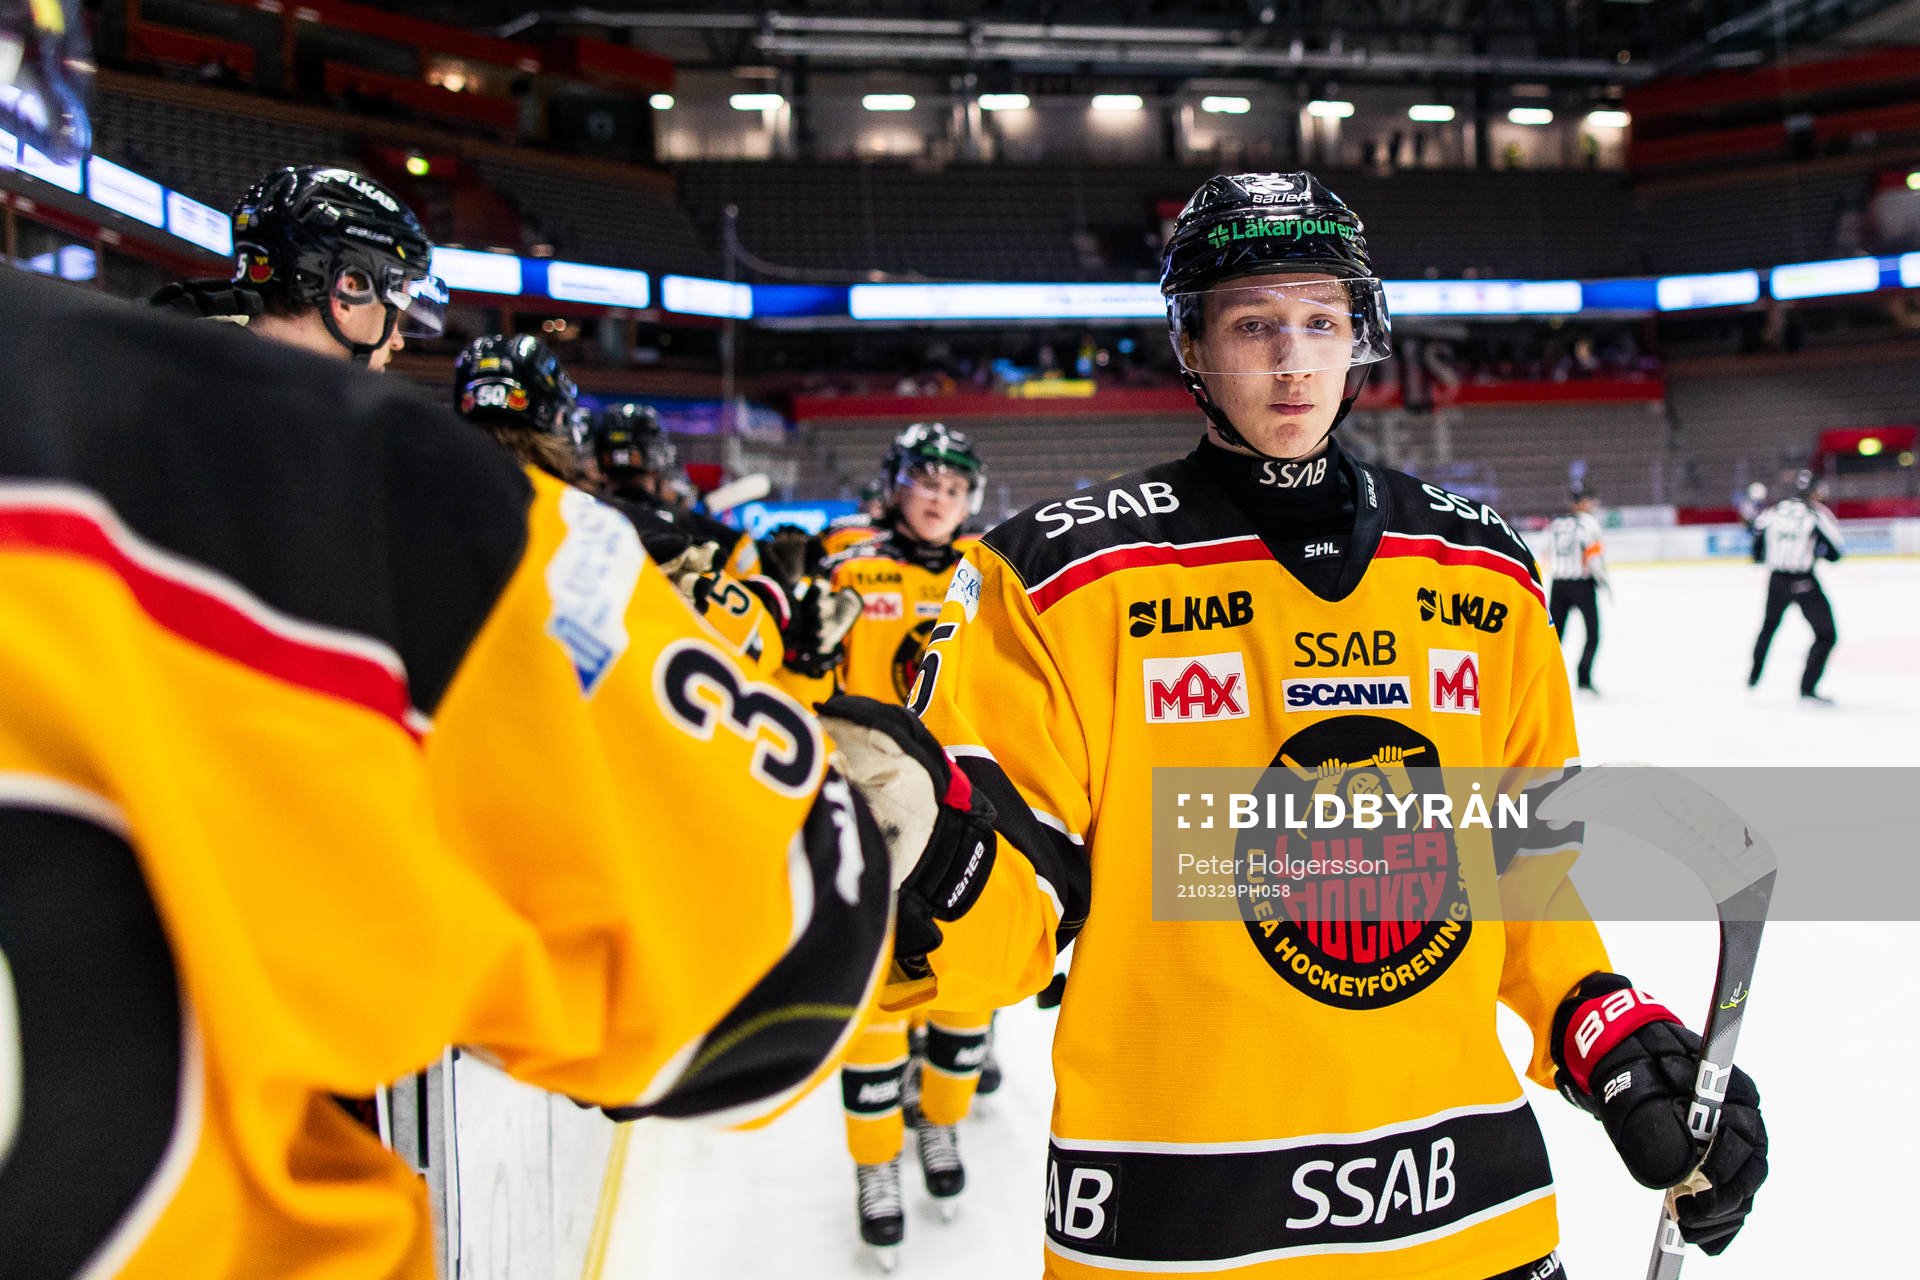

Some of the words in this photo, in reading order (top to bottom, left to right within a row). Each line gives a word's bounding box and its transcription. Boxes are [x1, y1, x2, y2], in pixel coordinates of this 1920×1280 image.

[1252, 192, 1312, 204] BAUER
[1259, 457, 1327, 489] SSAB
[1035, 481, 1180, 539] SSAB
[1421, 483, 1528, 551] SSA
[1304, 542, 1340, 558] SHL
[1161, 590, 1254, 634] LKAB
[1440, 592, 1508, 634] LKAB
[1294, 630, 1397, 668] SSAB
[1150, 659, 1245, 720] MAX
[1287, 683, 1409, 706] SCANIA
[1434, 654, 1480, 711] MA
[651, 637, 826, 799] 3
[947, 841, 985, 908] BAUER
[1280, 870, 1446, 964] HOCKEY
[1274, 900, 1469, 998] HOCKEYFÖRENING
[1045, 1159, 1114, 1240] AB
[1286, 1136, 1456, 1230] SSAB
